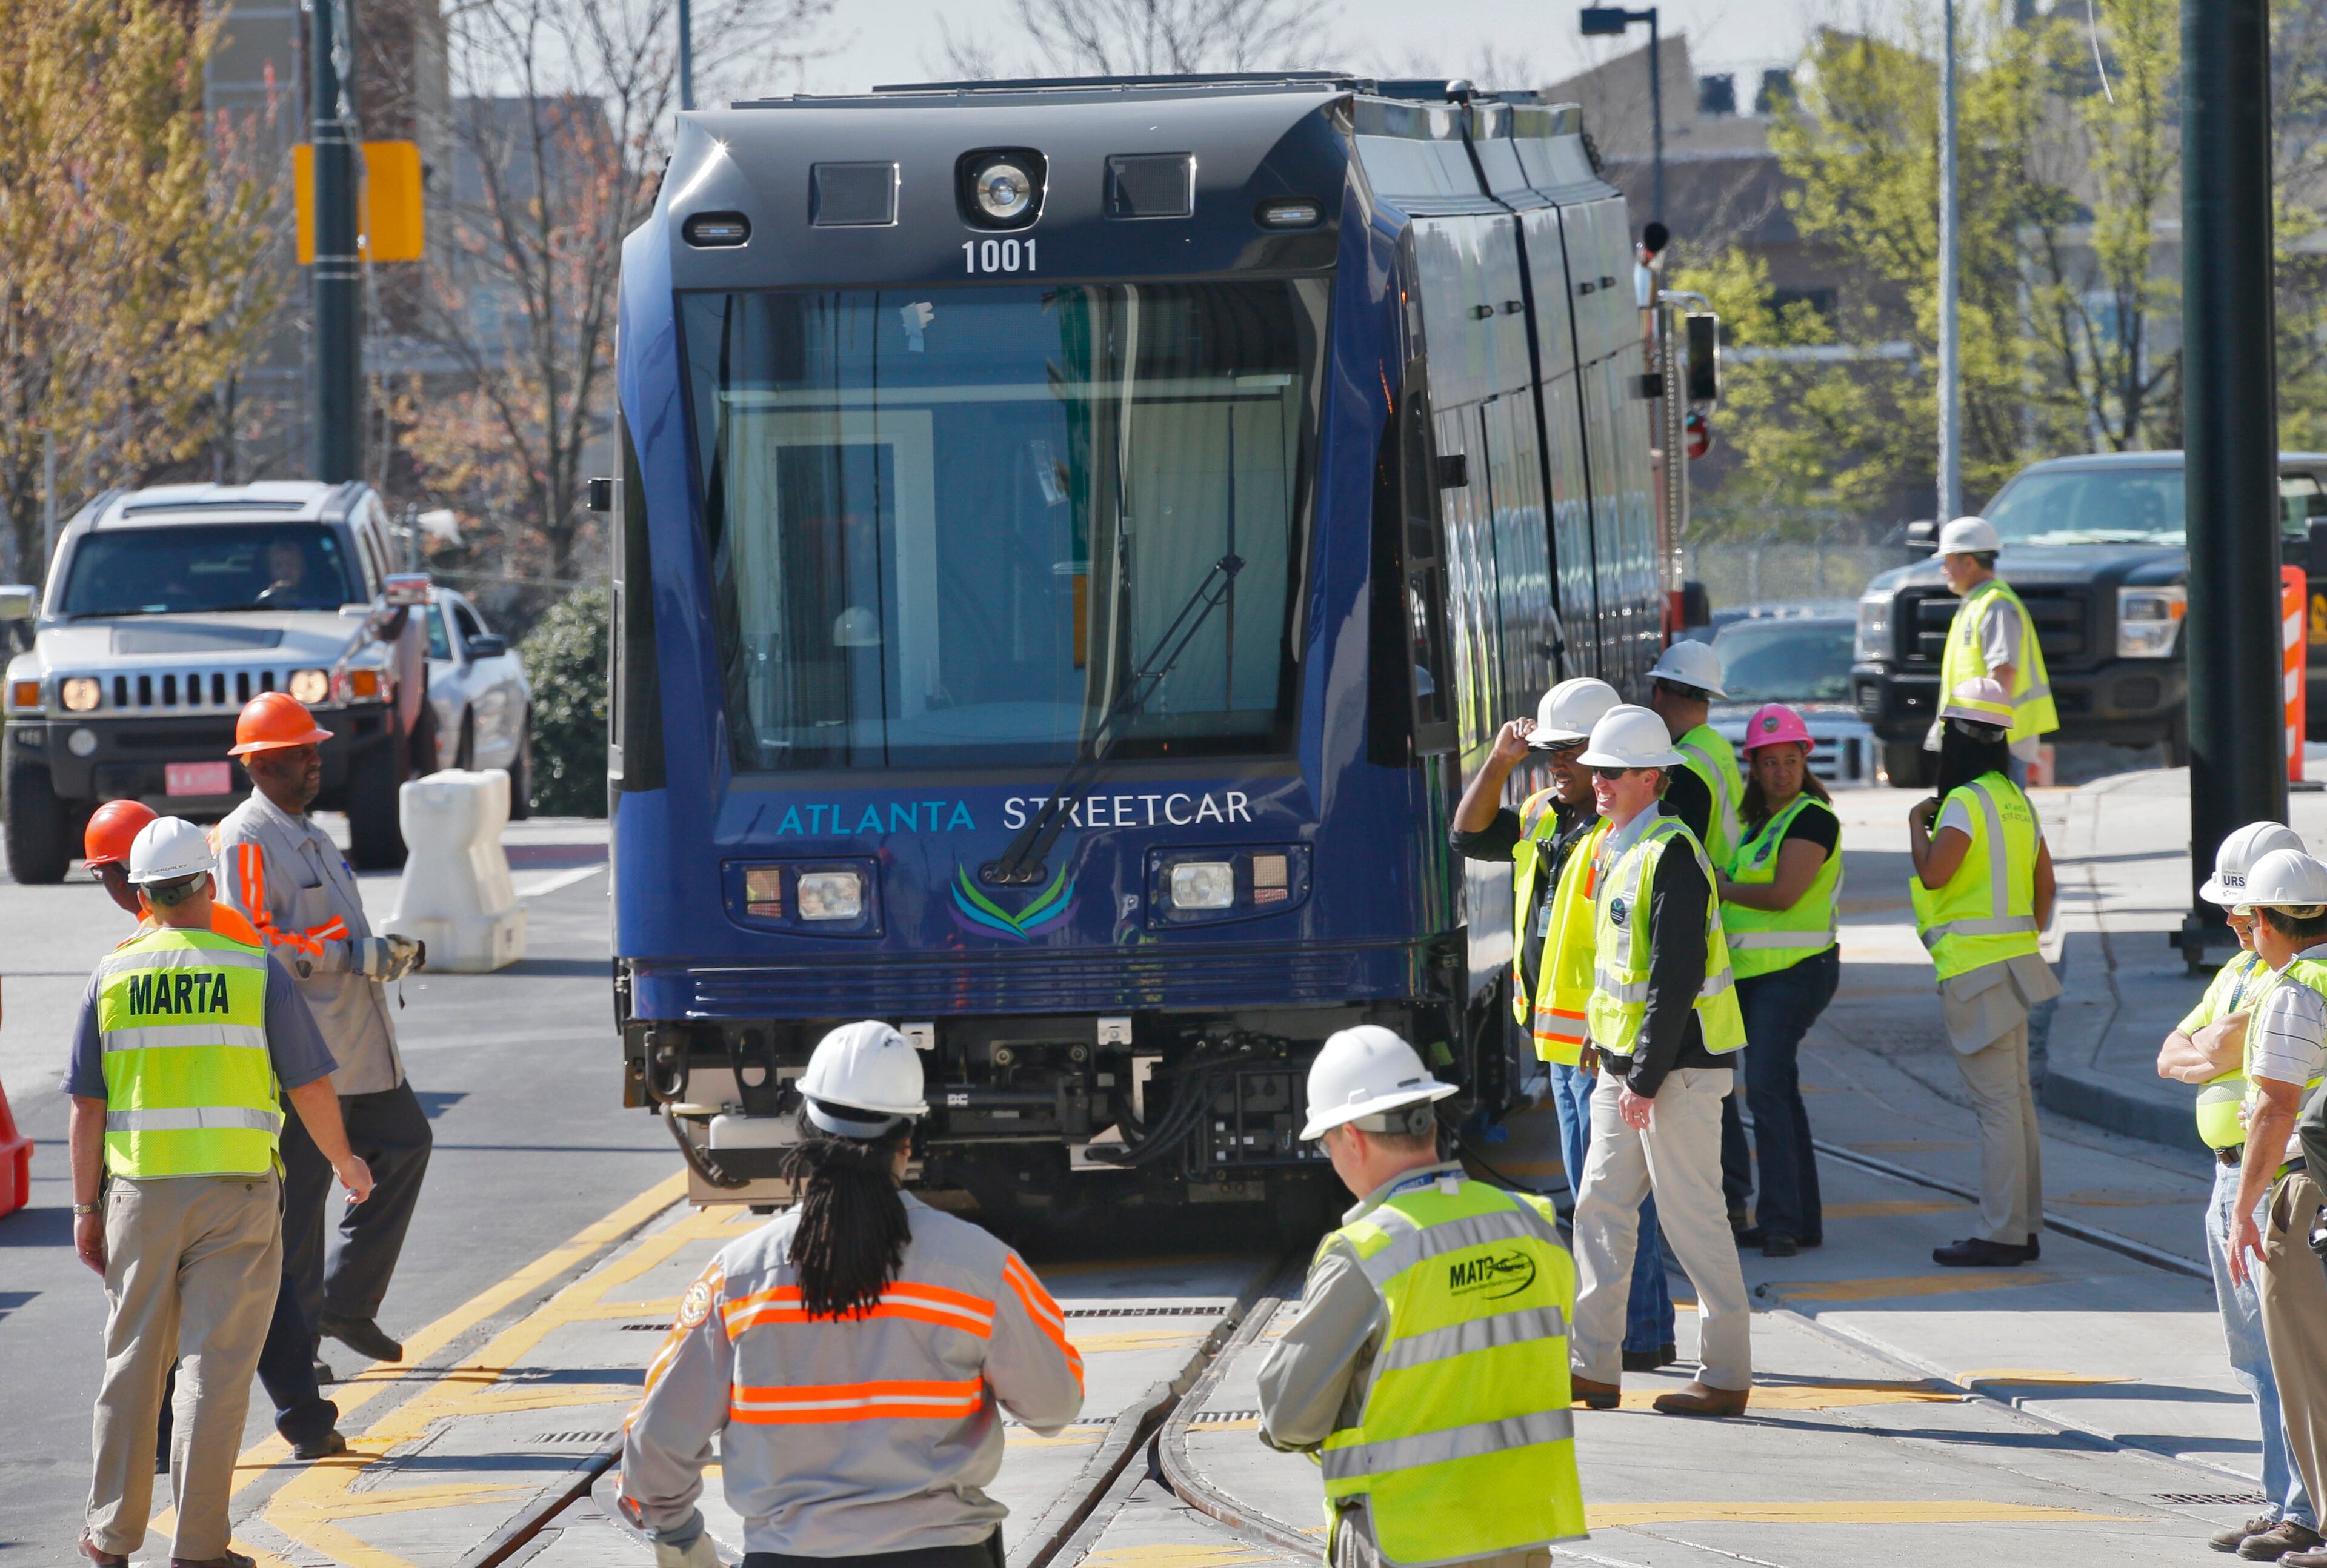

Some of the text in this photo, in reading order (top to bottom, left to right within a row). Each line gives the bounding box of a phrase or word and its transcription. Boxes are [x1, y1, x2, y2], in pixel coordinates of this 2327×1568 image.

[962, 239, 1037, 273] 1001
[776, 800, 976, 835] ATLANTA
[2223, 875, 2245, 887] URS
[129, 973, 229, 1015] MARTA
